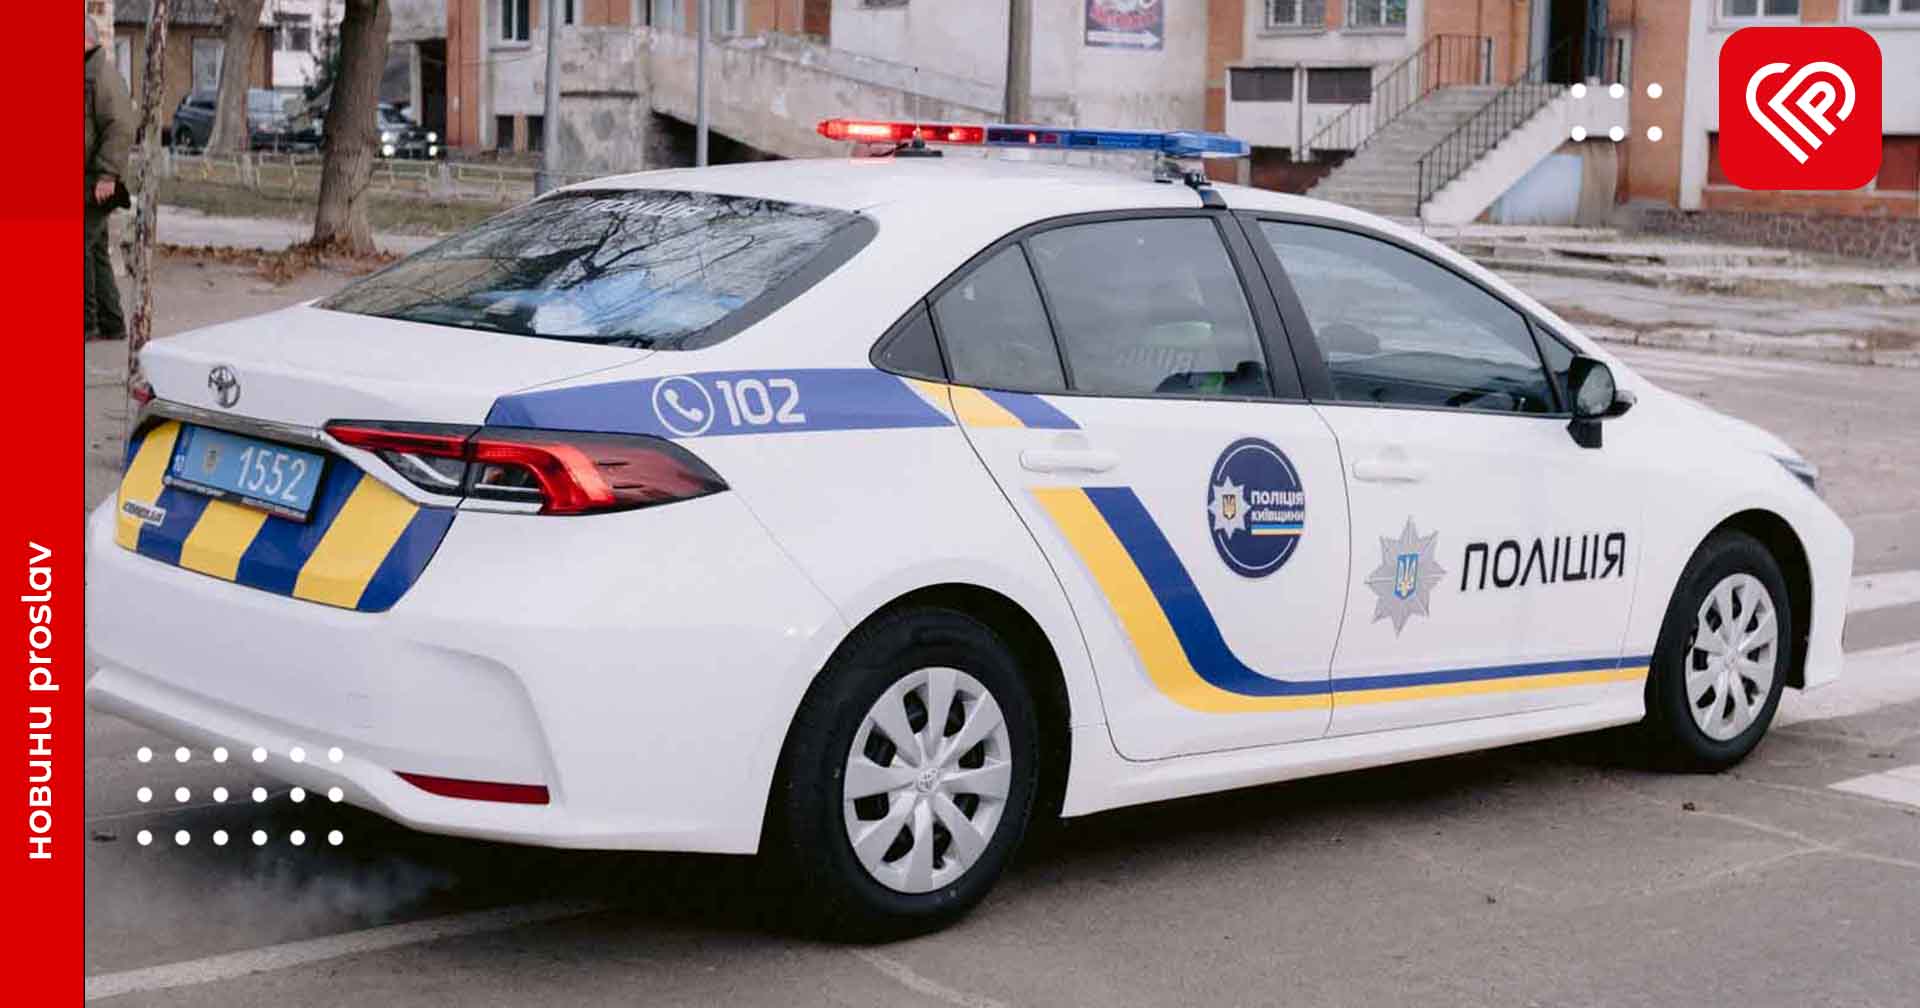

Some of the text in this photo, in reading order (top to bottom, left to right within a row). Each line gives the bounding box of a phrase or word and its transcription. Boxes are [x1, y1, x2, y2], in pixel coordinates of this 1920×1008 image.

[715, 378, 807, 427] 102
[238, 446, 306, 502] 1552
[1250, 490, 1305, 506] ПОЛІЦІЯ
[1460, 532, 1626, 592] ПОЛІЦІЯ
